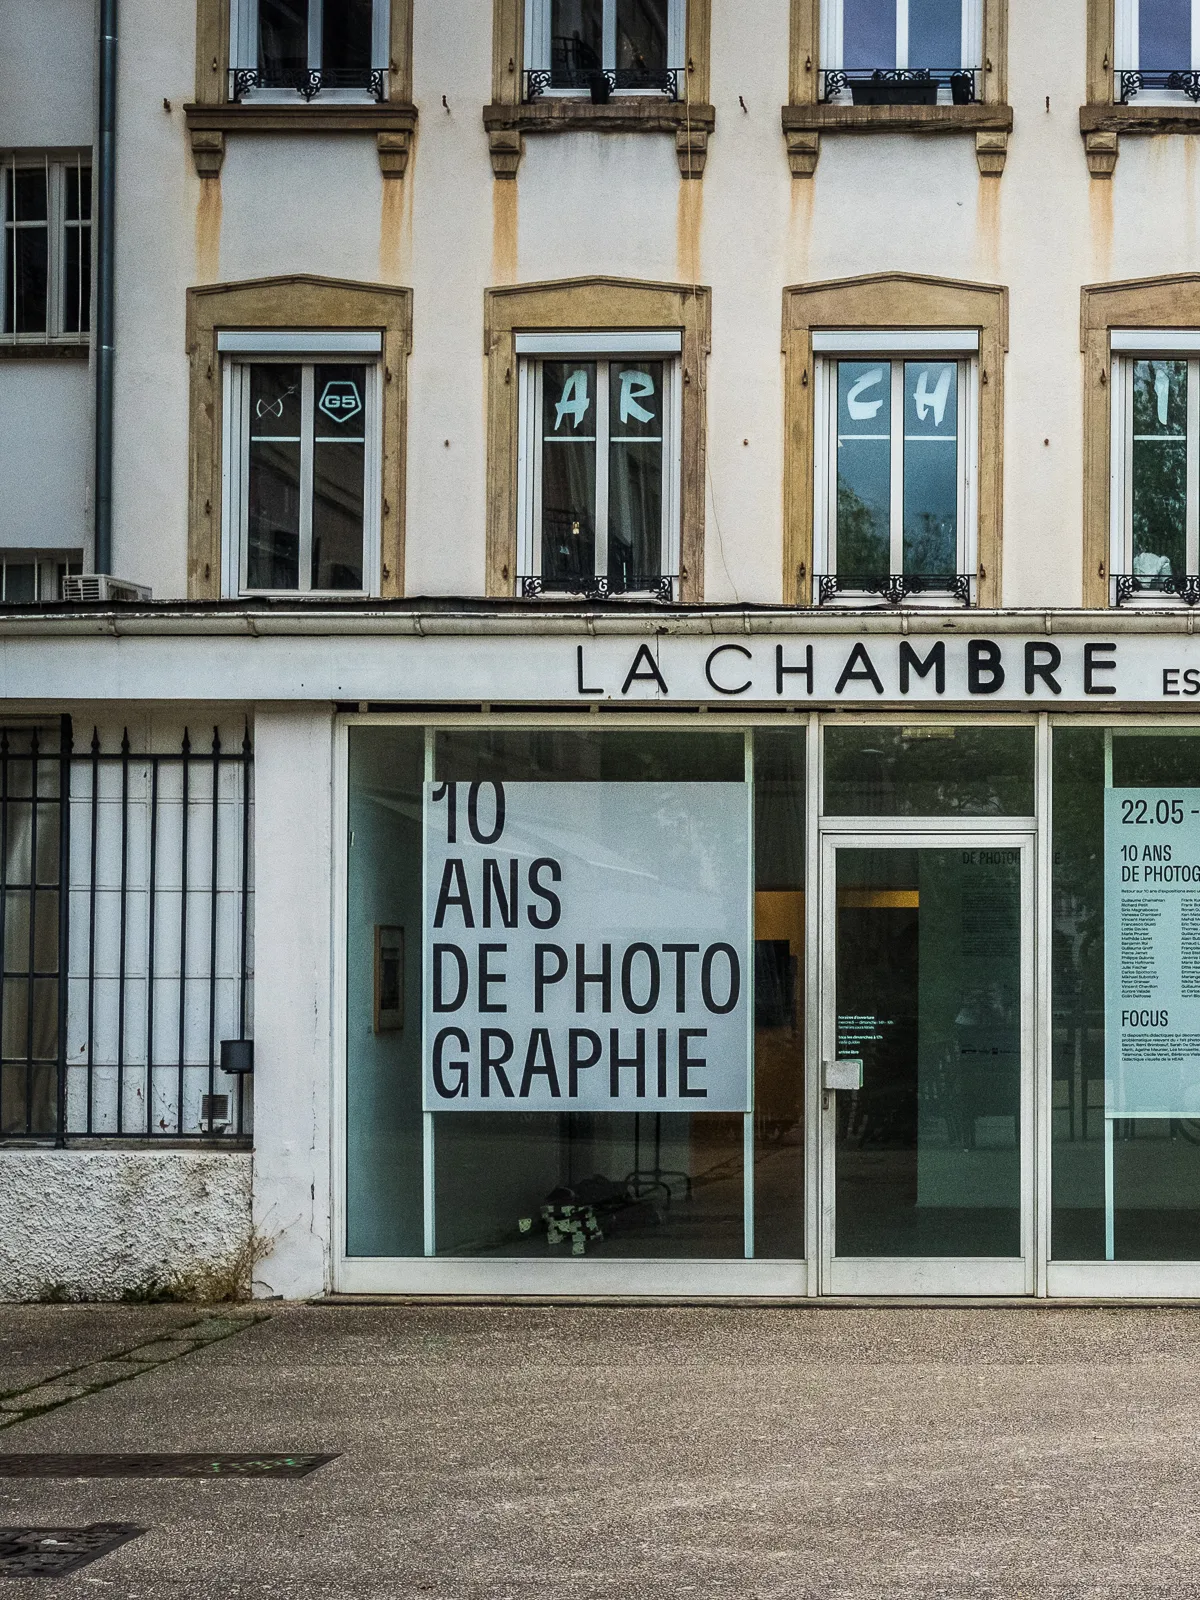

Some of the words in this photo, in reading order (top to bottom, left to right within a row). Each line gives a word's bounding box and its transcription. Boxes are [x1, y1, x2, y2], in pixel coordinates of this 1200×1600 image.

[324, 395, 356, 408] G5
[577, 644, 669, 695] LA
[705, 640, 1117, 695] CHAMBRE
[432, 782, 506, 844] 10
[1121, 799, 1184, 825] 22.05
[1120, 844, 1138, 862] 10
[1142, 844, 1172, 862] ANS
[433, 857, 562, 930] ANS
[1121, 865, 1140, 882] DE
[432, 943, 508, 1013] DE
[534, 942, 741, 1015] PHOTO
[1121, 1009, 1169, 1027] FOCUS
[432, 1026, 708, 1098] GRAPHIE
